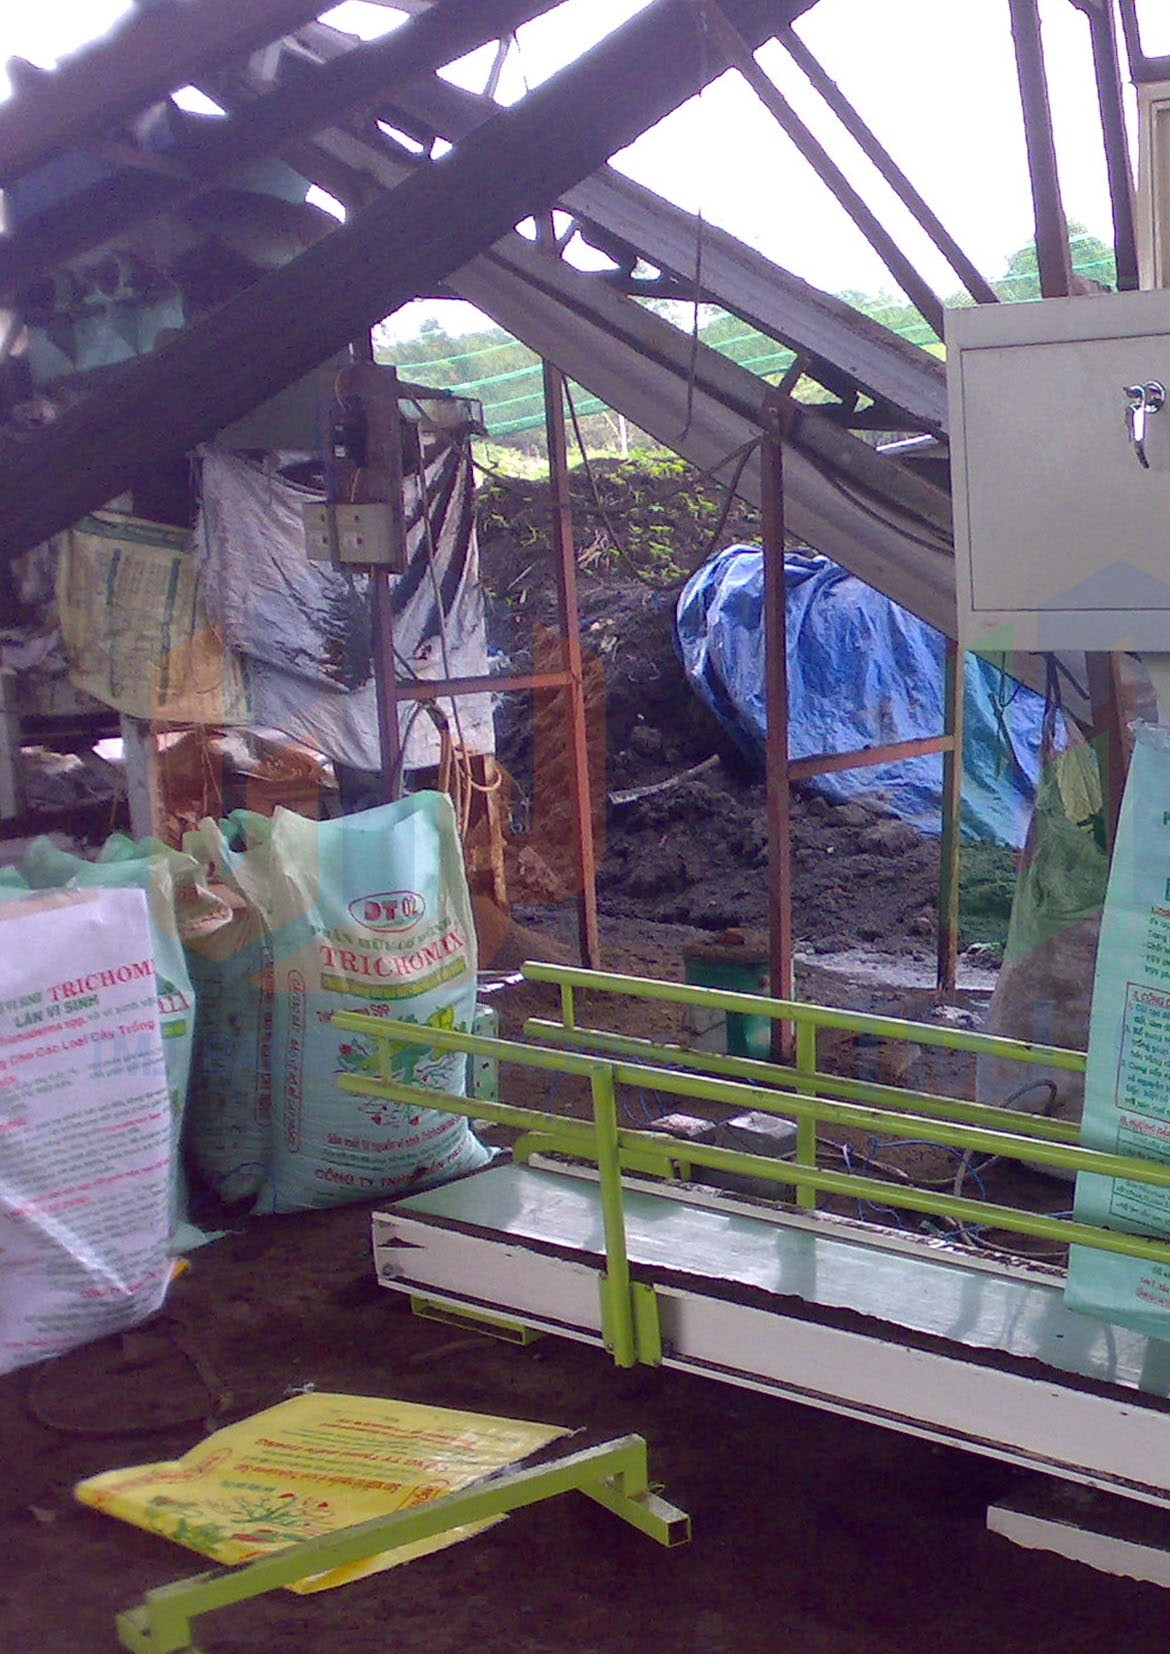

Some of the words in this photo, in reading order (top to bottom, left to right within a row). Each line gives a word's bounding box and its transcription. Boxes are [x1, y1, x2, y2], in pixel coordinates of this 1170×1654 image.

[64, 993, 99, 1014] SINH
[315, 1167, 355, 1187] CÔNG
[358, 1176, 374, 1188] TY
